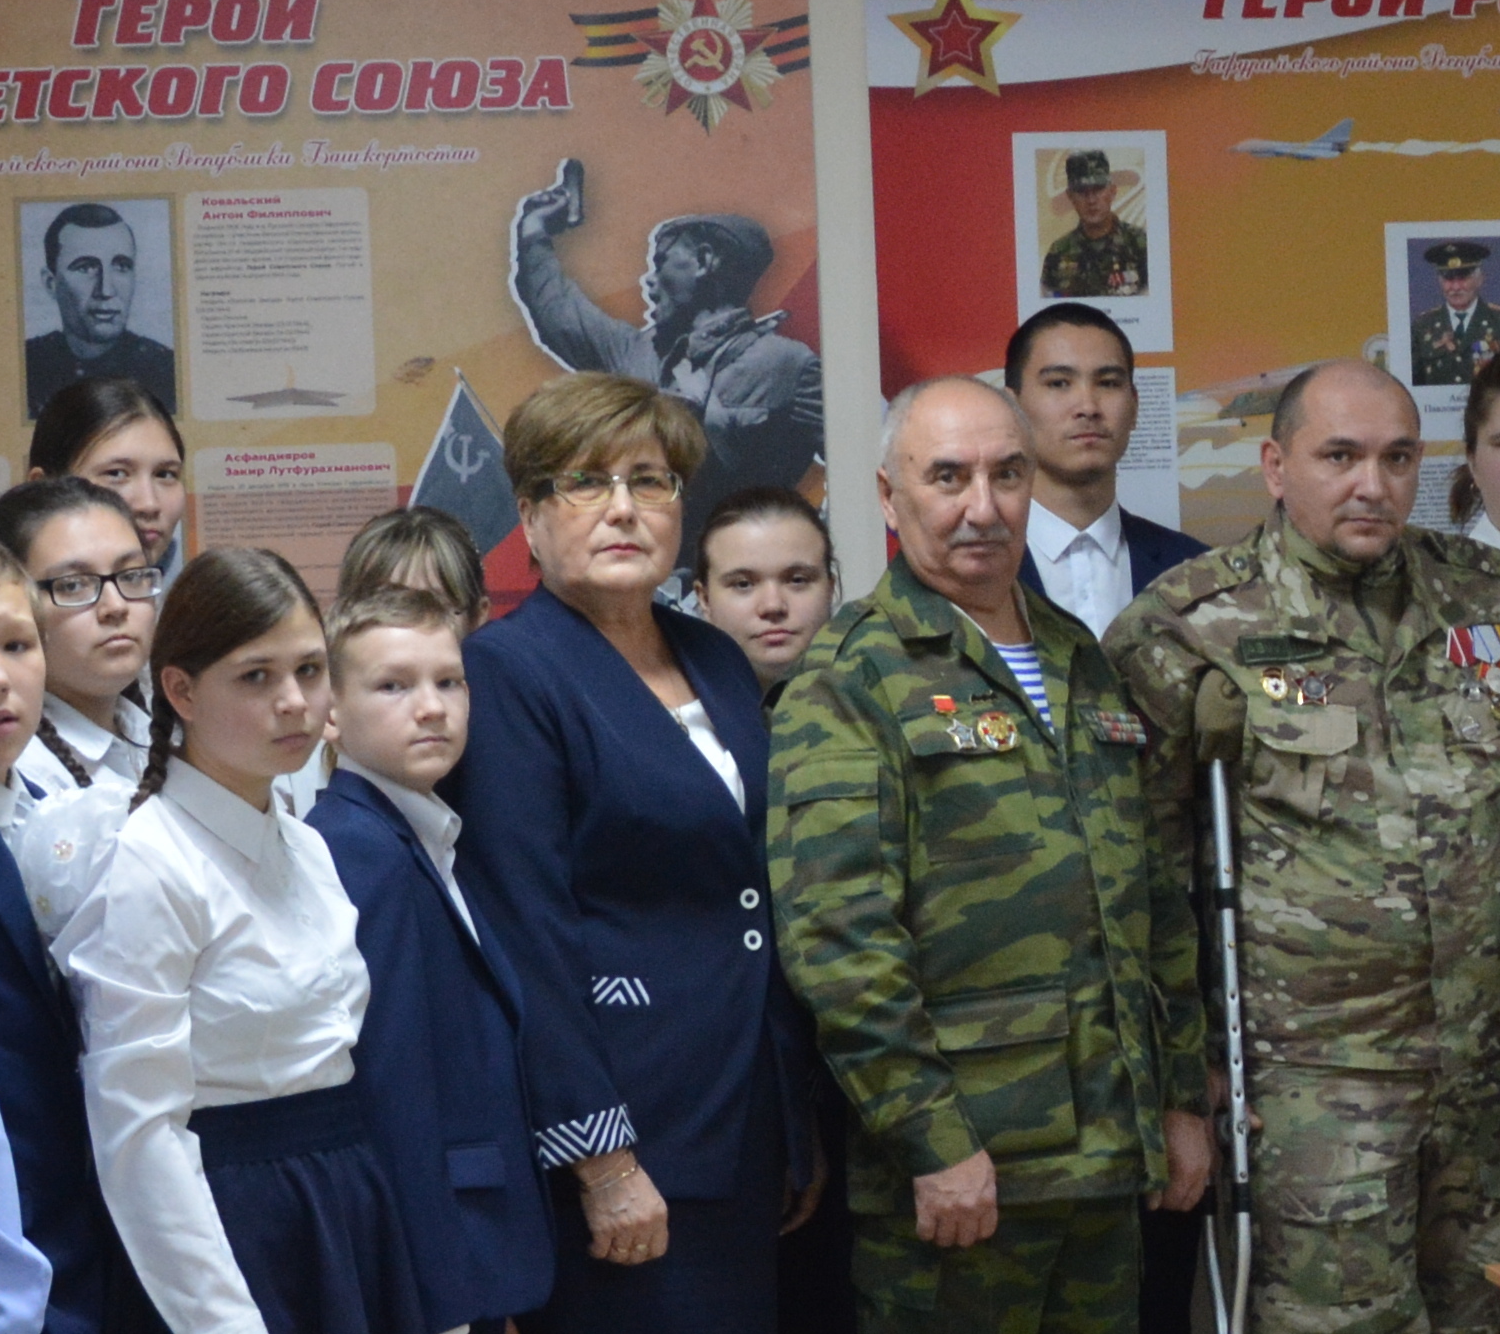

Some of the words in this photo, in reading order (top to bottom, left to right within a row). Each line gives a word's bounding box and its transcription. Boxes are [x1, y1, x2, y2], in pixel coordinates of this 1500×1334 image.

[1191, 48, 1338, 80] Гафурийского
[1343, 52, 1417, 75] района
[309, 58, 572, 115] СОЮЗА
[80, 153, 162, 177] района
[166, 141, 291, 177] Республики
[303, 139, 479, 171] Башкортостан
[202, 196, 281, 206] Ковальский
[202, 211, 243, 220] Антон
[247, 209, 331, 219] Филиппович
[225, 452, 315, 463] Асфандияров
[226, 467, 264, 477] Закир
[269, 464, 390, 475] Лутфурахманович
